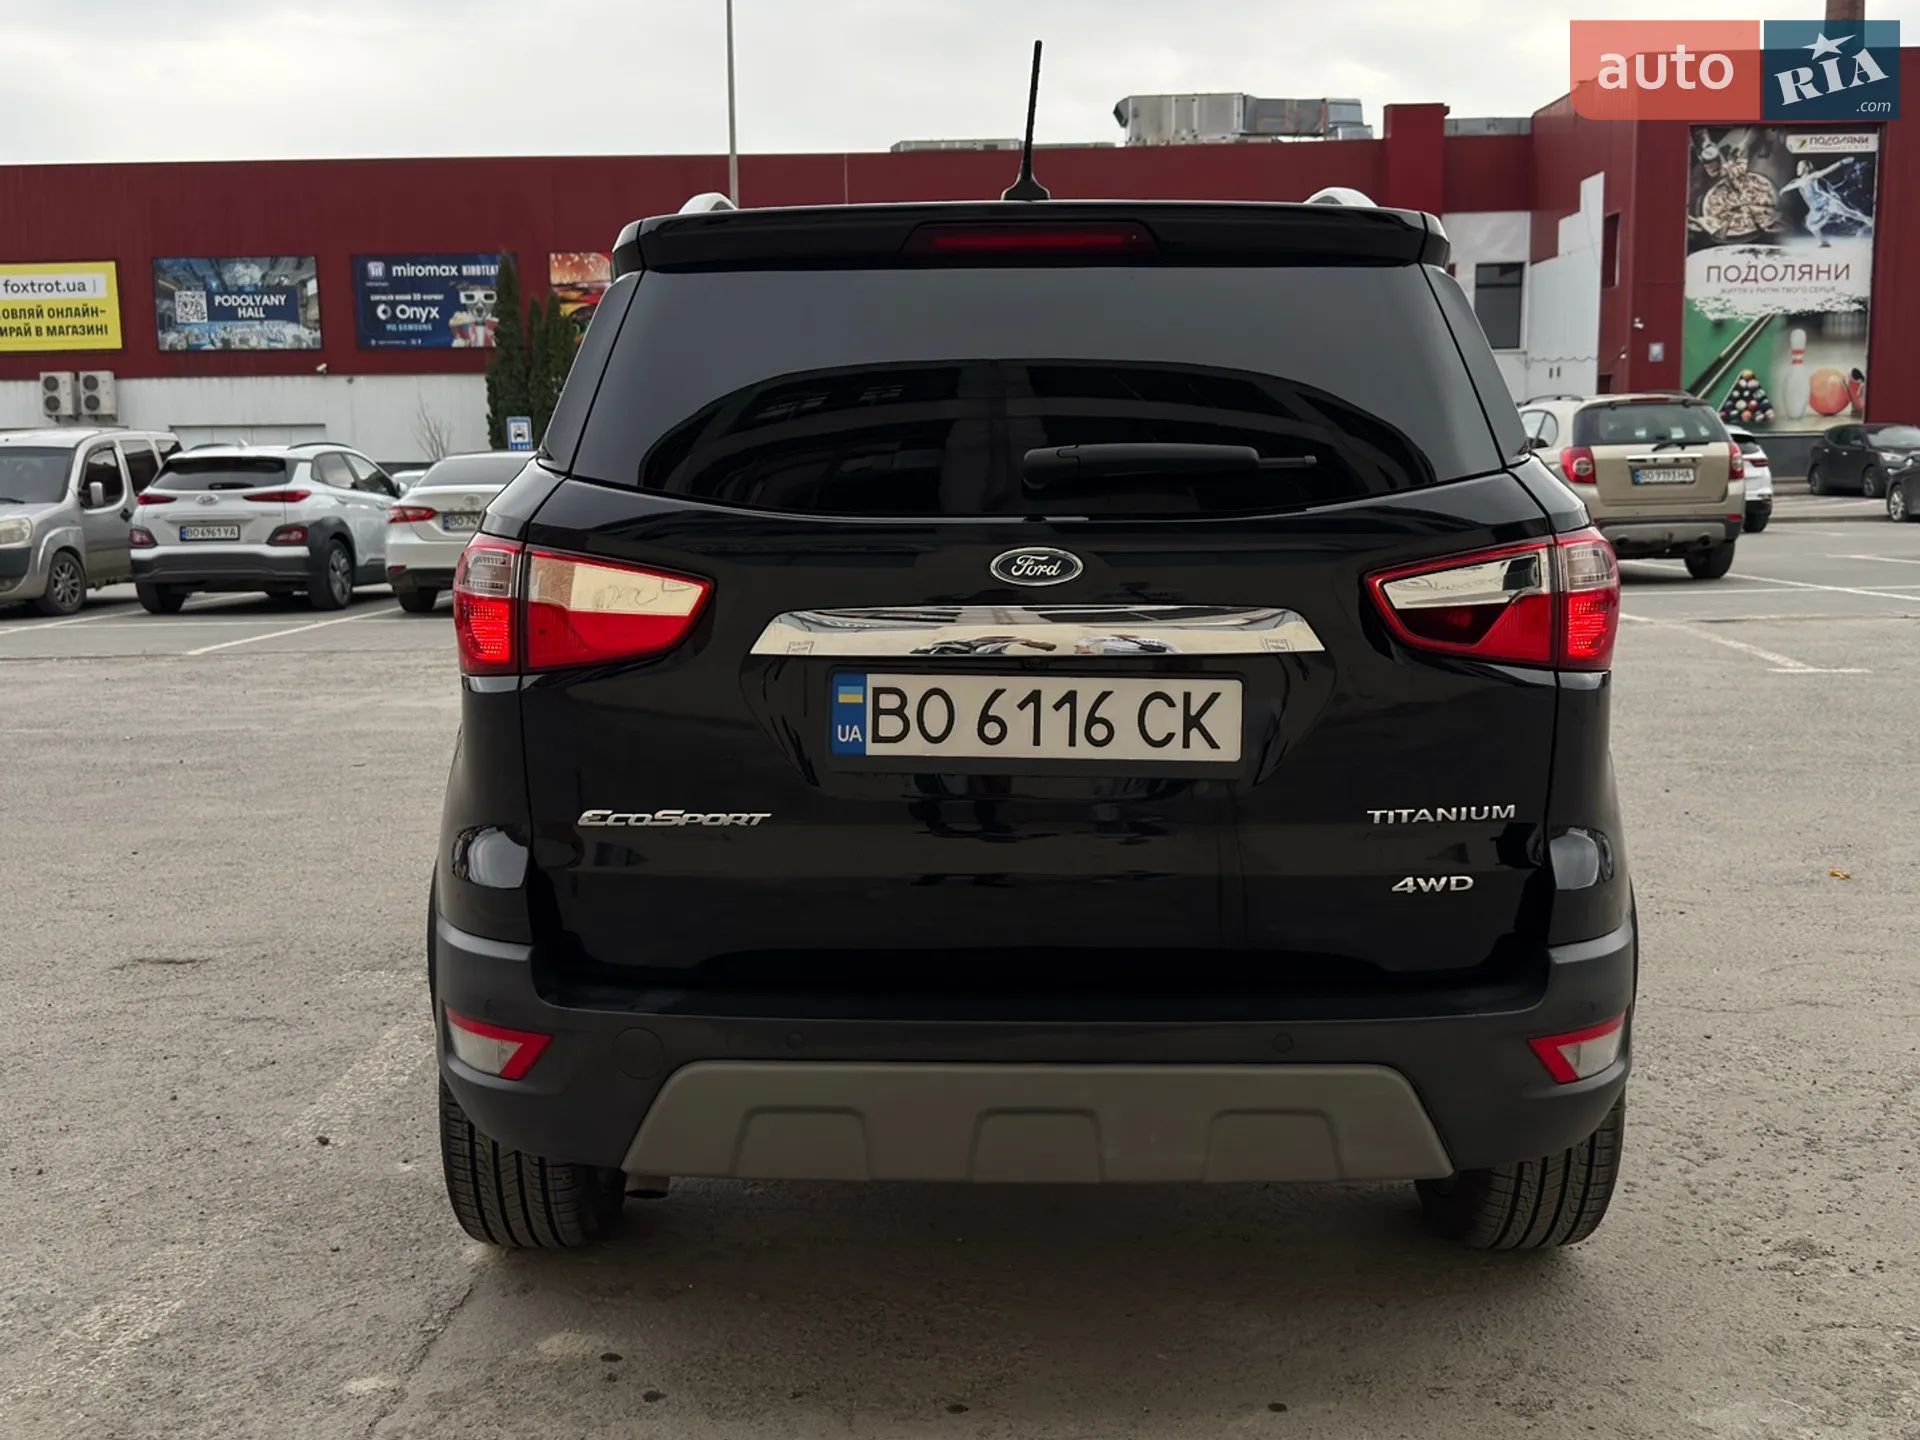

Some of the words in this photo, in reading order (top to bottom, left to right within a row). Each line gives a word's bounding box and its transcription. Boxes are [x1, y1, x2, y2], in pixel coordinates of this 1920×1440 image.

[392, 263, 459, 277] miromax
[1706, 263, 1850, 284] ПОДОЛЯНИ
[3, 279, 87, 294] foxtrot.ua
[214, 294, 287, 307] PODOLYANY
[238, 307, 266, 318] HALL
[395, 304, 440, 323] Onyx
[35, 326, 43, 337] В
[46, 324, 108, 337] МАГАЗИНІ
[1011, 554, 1061, 576] Ford
[871, 686, 955, 746] BO
[976, 688, 1115, 748] 6116
[1137, 691, 1222, 749] CK
[837, 725, 862, 743] UA
[1367, 804, 1516, 824] TITANIUM
[1391, 875, 1475, 893] 4WD
